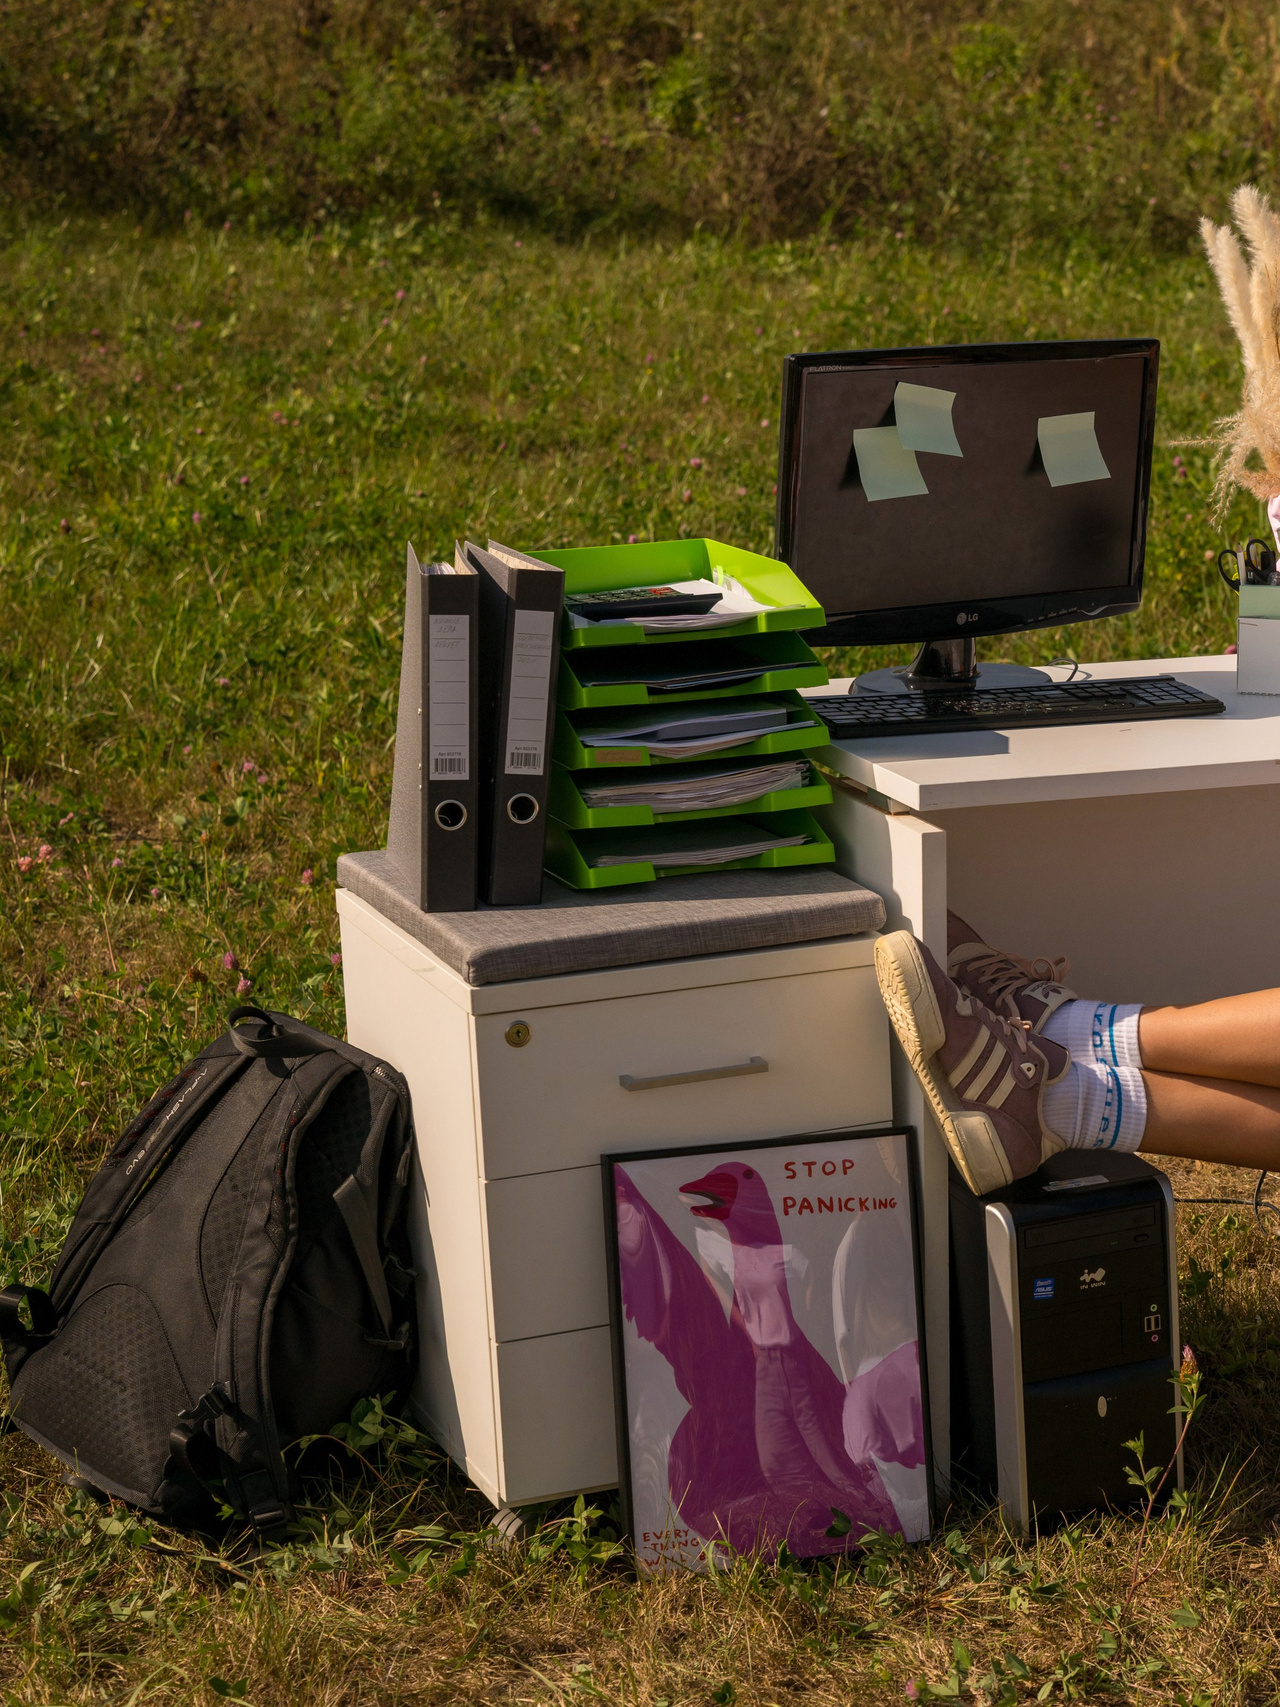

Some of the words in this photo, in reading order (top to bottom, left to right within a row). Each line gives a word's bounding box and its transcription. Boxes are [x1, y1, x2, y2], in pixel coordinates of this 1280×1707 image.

[783, 1158, 855, 1180] STOP
[782, 1195, 898, 1216] PANICKING
[642, 1529, 690, 1543] EVERY
